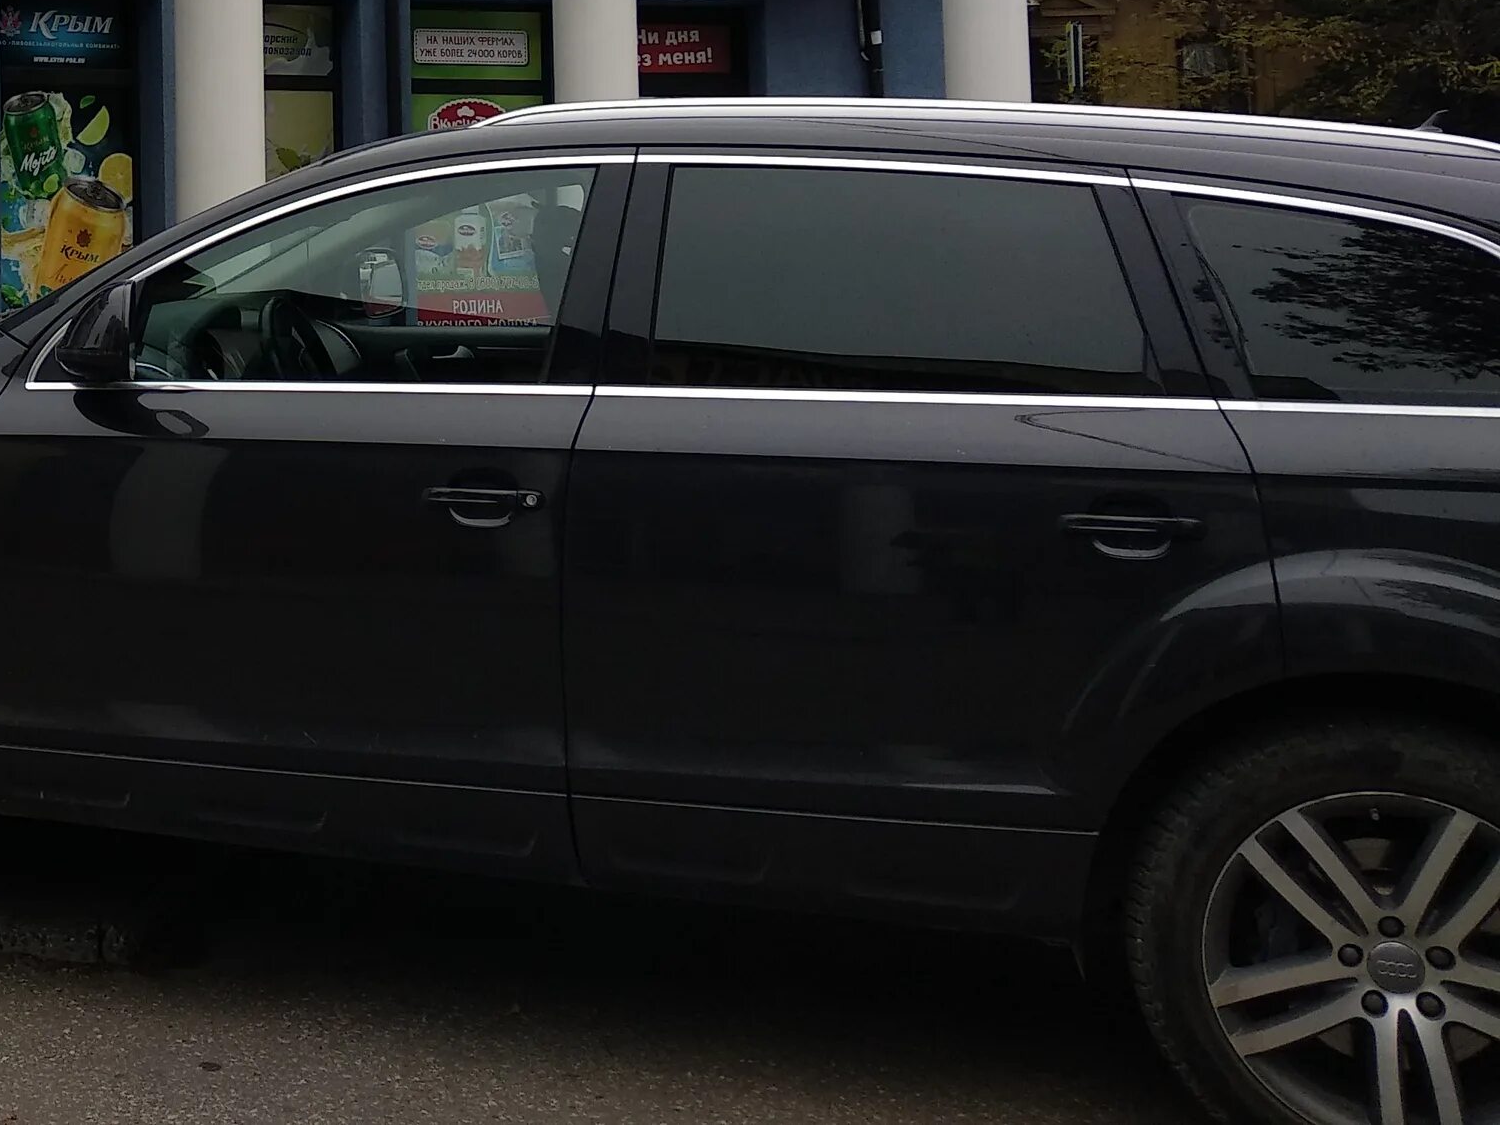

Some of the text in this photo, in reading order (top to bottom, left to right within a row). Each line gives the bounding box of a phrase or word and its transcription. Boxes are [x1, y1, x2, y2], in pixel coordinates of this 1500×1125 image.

[426, 36, 515, 46] НА НАШИХ ФЕРМАХ
[665, 29, 701, 47] дня
[419, 48, 437, 57] УЖЕ
[440, 48, 465, 58] БОЛЕЕ
[497, 49, 523, 59] КОРОВ
[658, 46, 714, 67] меня!
[452, 299, 504, 315] РОДИНА
